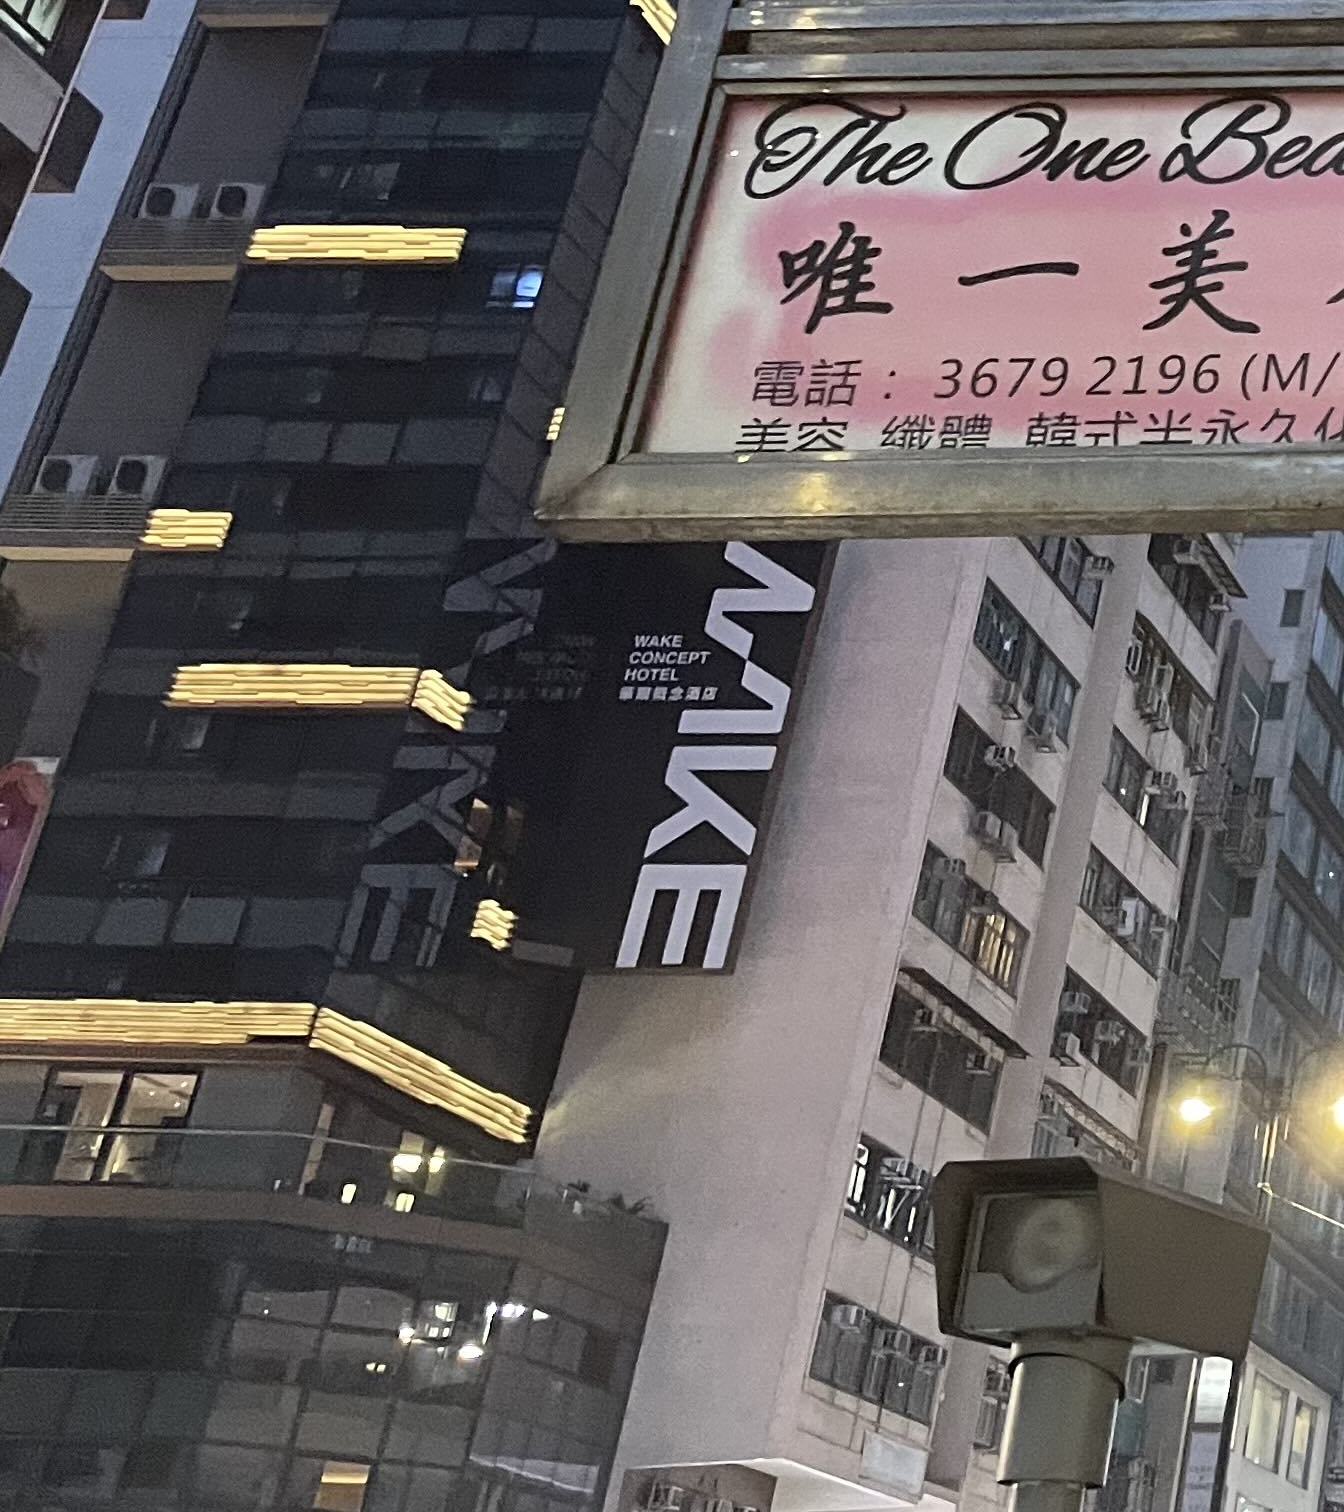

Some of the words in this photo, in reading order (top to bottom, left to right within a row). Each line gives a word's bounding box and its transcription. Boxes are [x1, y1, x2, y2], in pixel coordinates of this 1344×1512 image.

[744, 96, 934, 200] The
[944, 102, 1151, 191] One
[934, 357, 1070, 401] 3679
[1089, 352, 1220, 398] 2196
[634, 635, 683, 648] WAKE
[629, 651, 712, 665] CONCEPT
[624, 668, 680, 681] HOTEL
